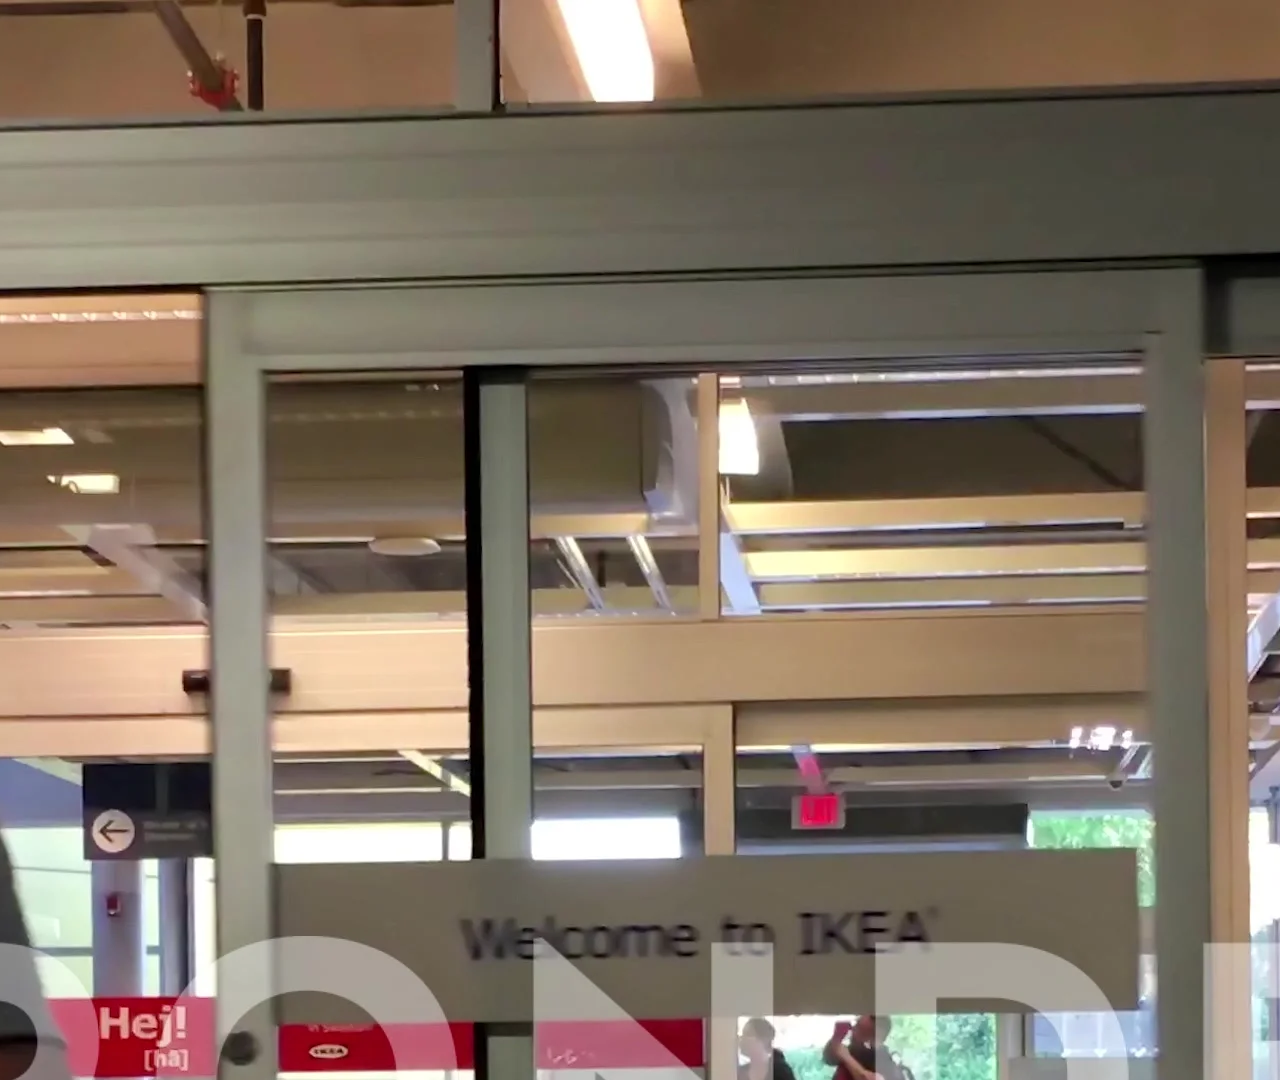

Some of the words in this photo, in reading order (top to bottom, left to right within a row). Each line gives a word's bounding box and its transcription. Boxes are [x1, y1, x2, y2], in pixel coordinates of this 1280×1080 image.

[458, 914, 701, 961] Welcome
[720, 914, 776, 957] to
[99, 1005, 187, 1048] Hej!
